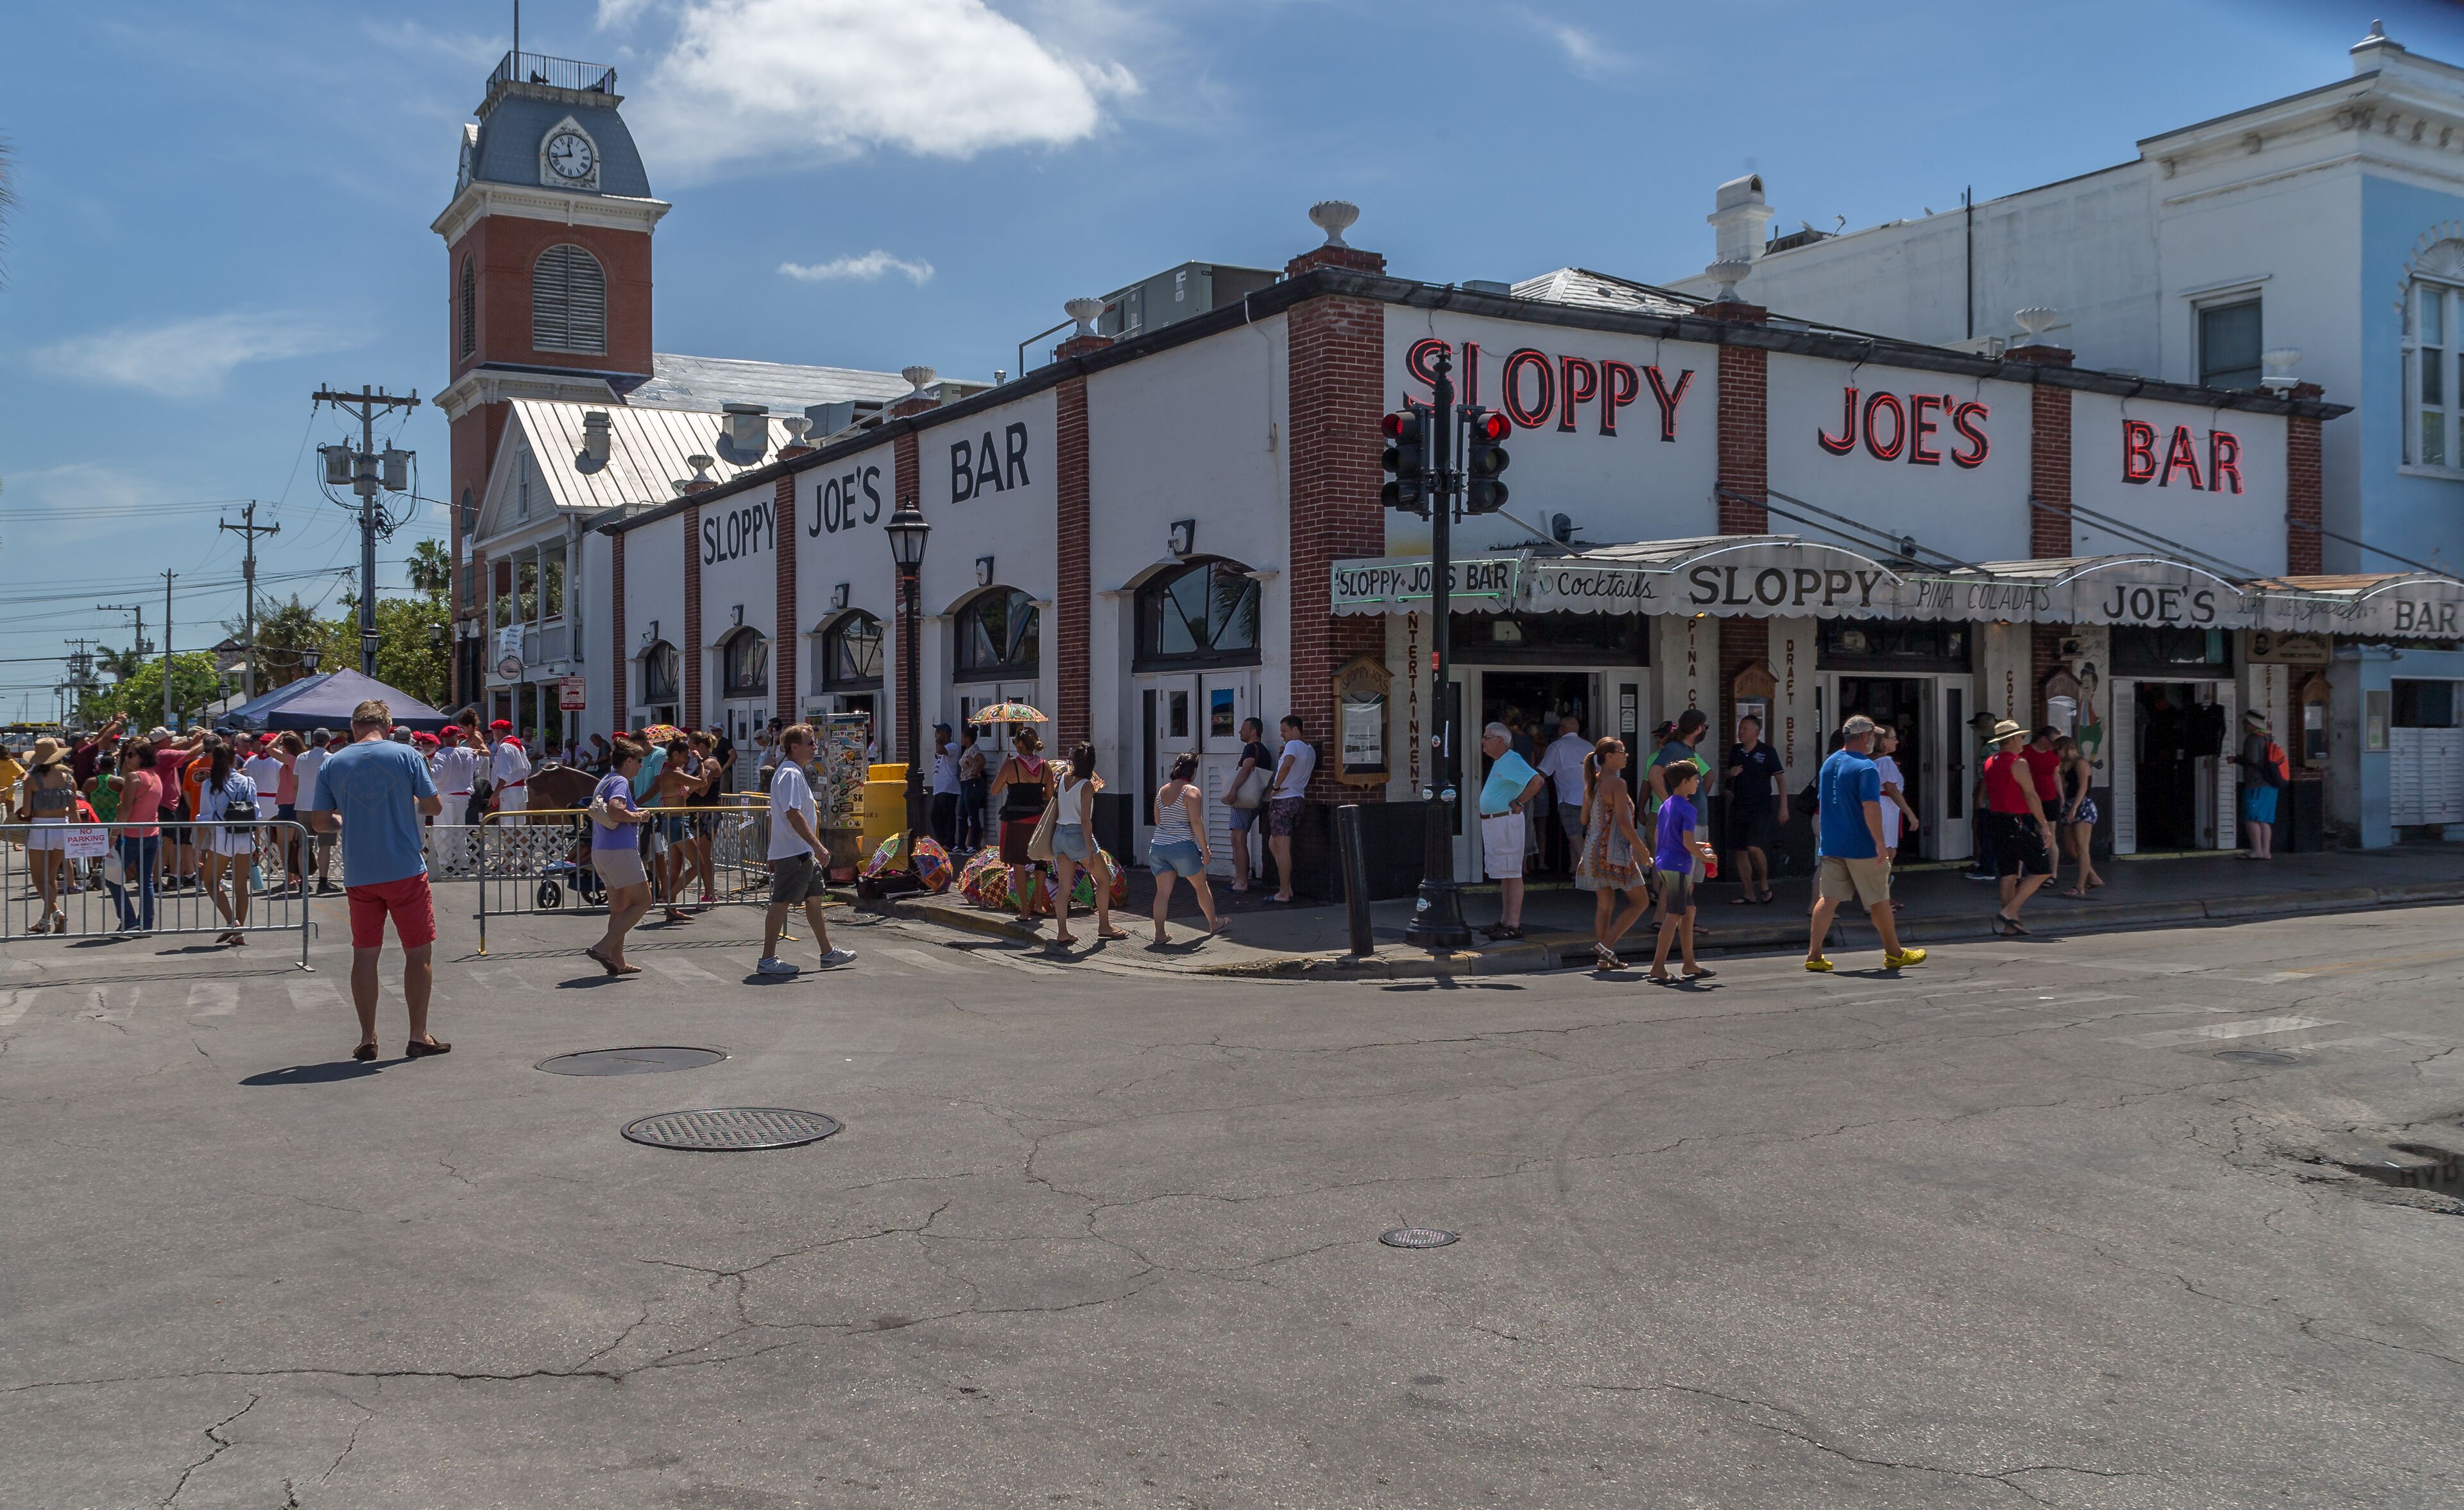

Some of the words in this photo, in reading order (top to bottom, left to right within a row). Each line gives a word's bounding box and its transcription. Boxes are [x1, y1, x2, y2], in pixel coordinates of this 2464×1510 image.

[1403, 338, 1695, 443] SLOPPY
[1818, 387, 1990, 469] JOE'S
[2122, 419, 2245, 495] BAR
[703, 497, 777, 566] SLOPPY
[809, 465, 881, 538] JOE'S
[950, 421, 1031, 504] BAR
[1339, 568, 1401, 597] SLOPPY
[1408, 565, 1456, 593] JOS
[1466, 564, 1509, 591] BAR
[1557, 572, 1659, 598] Cocktails
[1688, 565, 1884, 607] SLOPPY
[1967, 582, 2051, 611] COLADAS
[2103, 585, 2216, 623] JOE'S
[2393, 600, 2459, 633] BAR
[1786, 639, 1795, 706] DRAFT
[1408, 610, 1420, 794] NTERTAINMENT
[1786, 717, 1795, 768] BEER
[67, 835, 105, 843] PARKING
